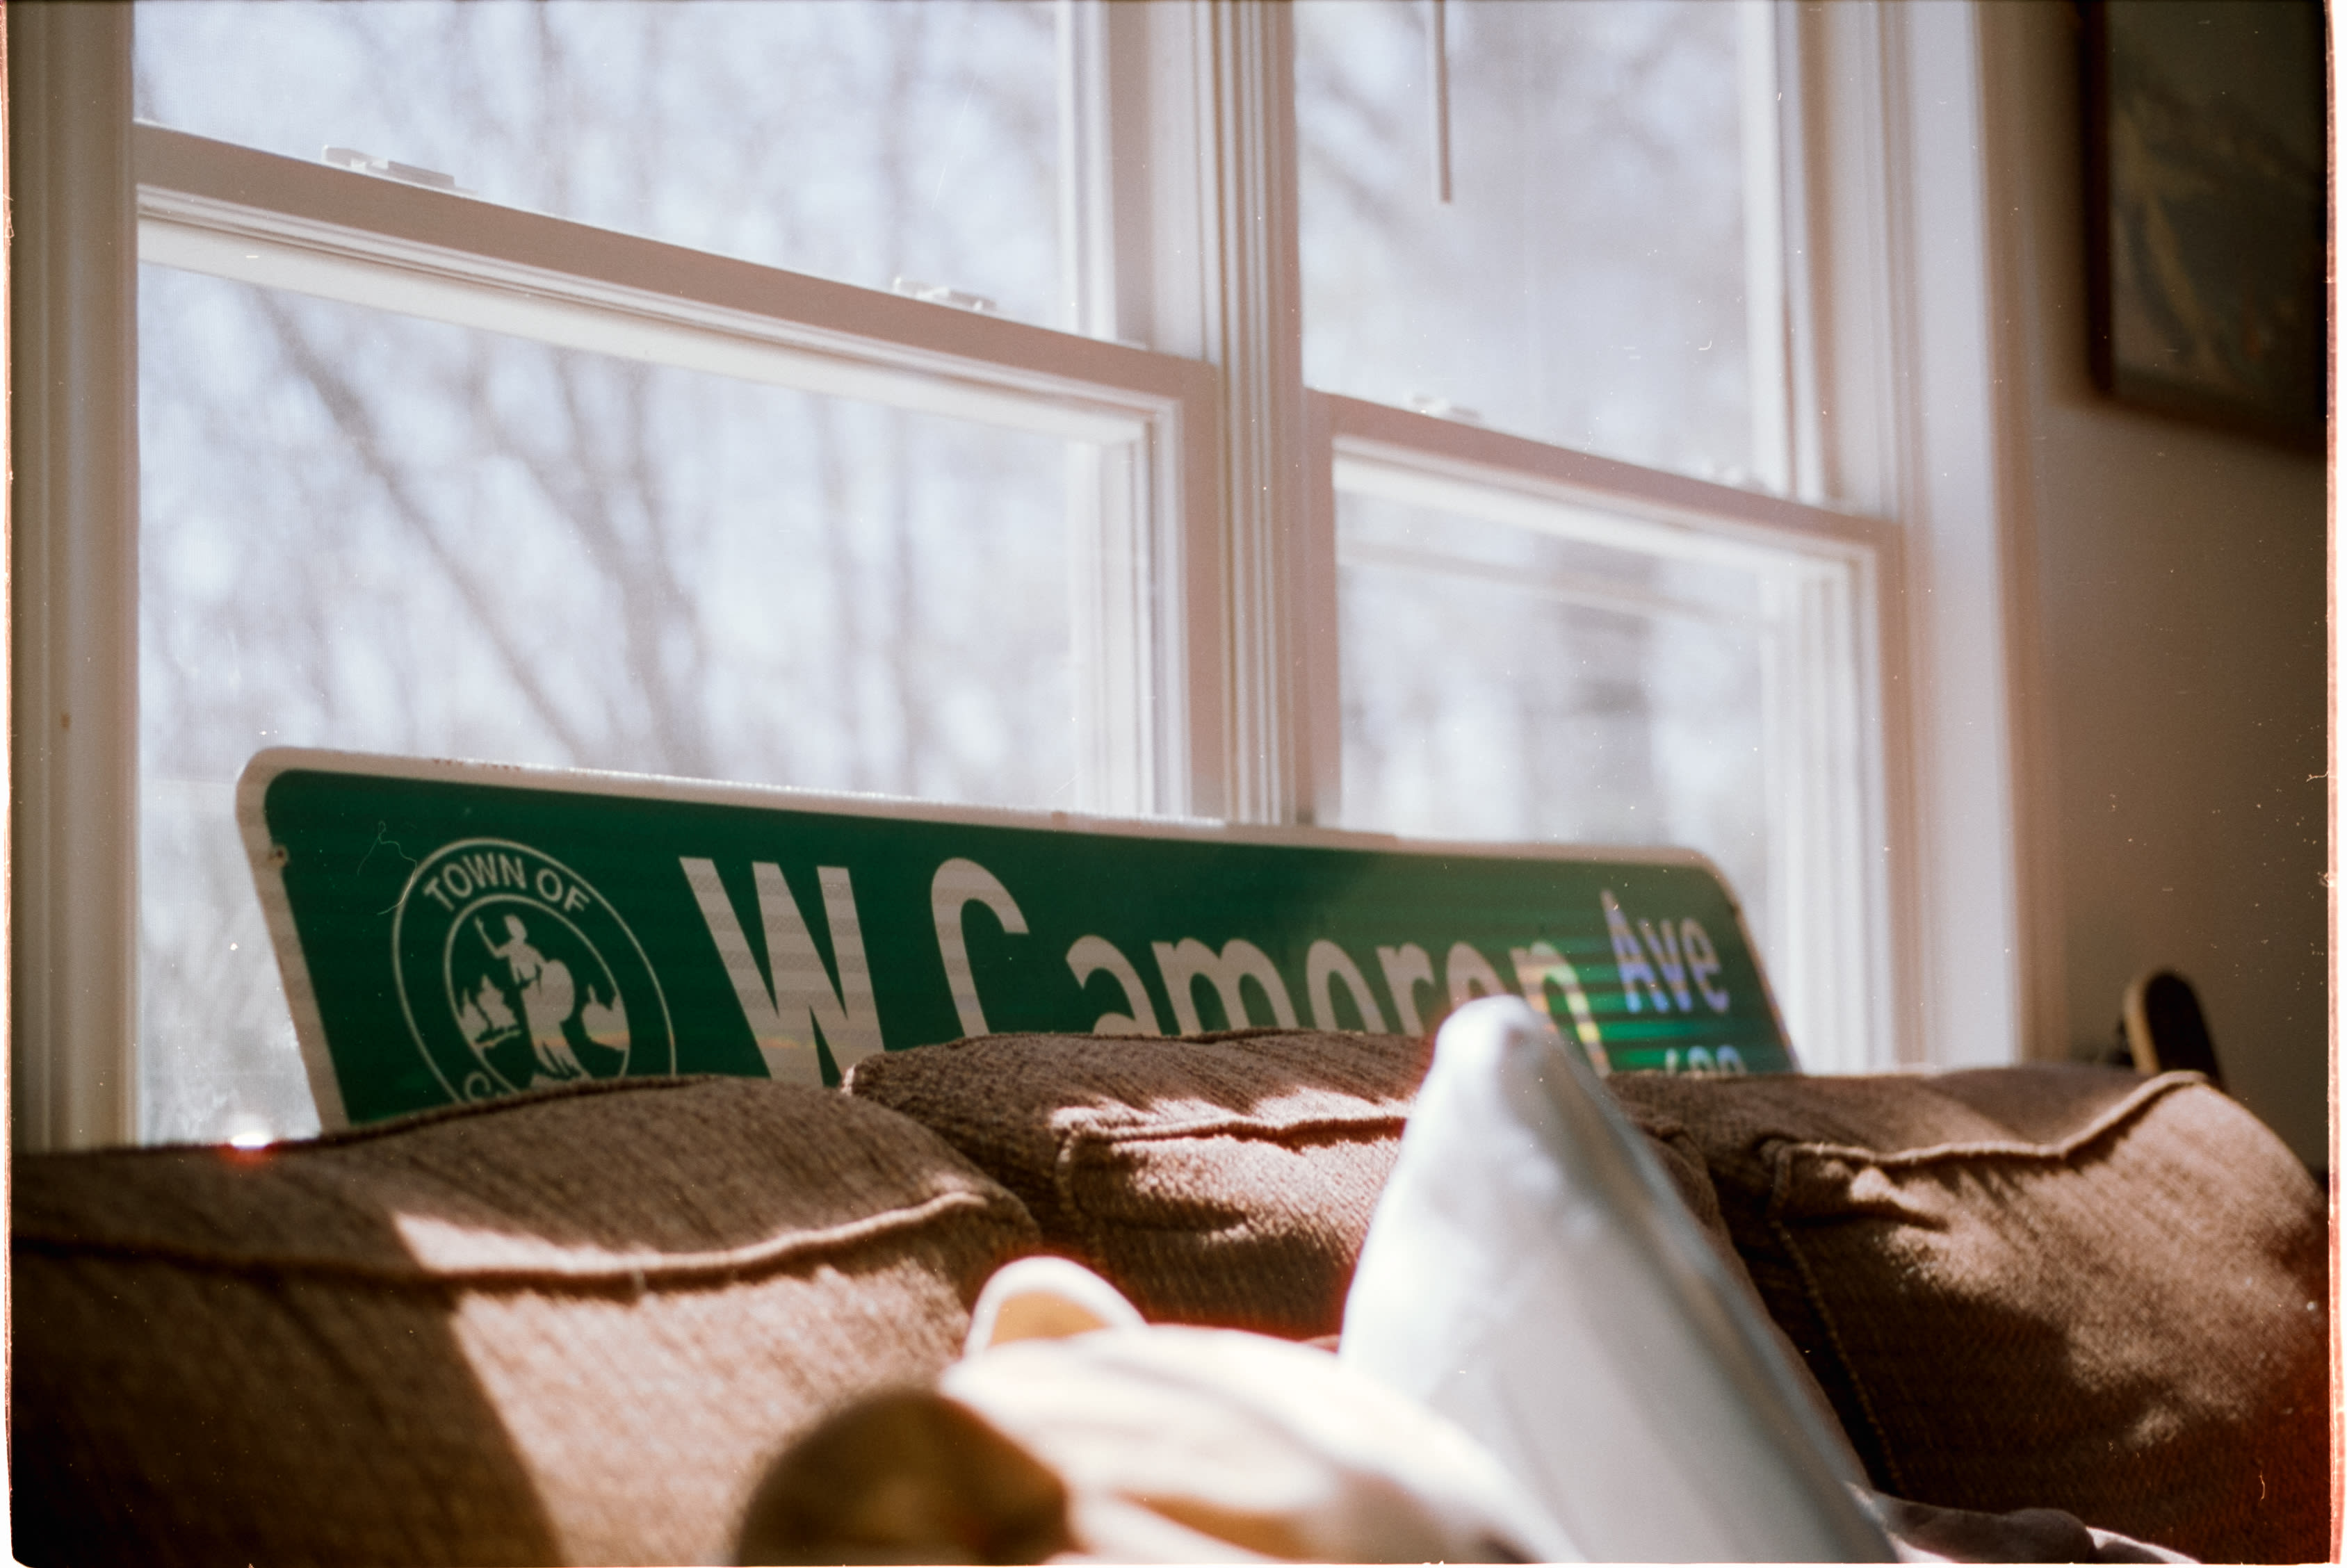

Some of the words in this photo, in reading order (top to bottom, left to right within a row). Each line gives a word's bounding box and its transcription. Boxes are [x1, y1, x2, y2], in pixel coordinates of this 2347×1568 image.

[422, 852, 528, 911] TOWN
[536, 867, 591, 913] OF
[678, 856, 884, 1087] W
[1600, 888, 1730, 1014] Ave
